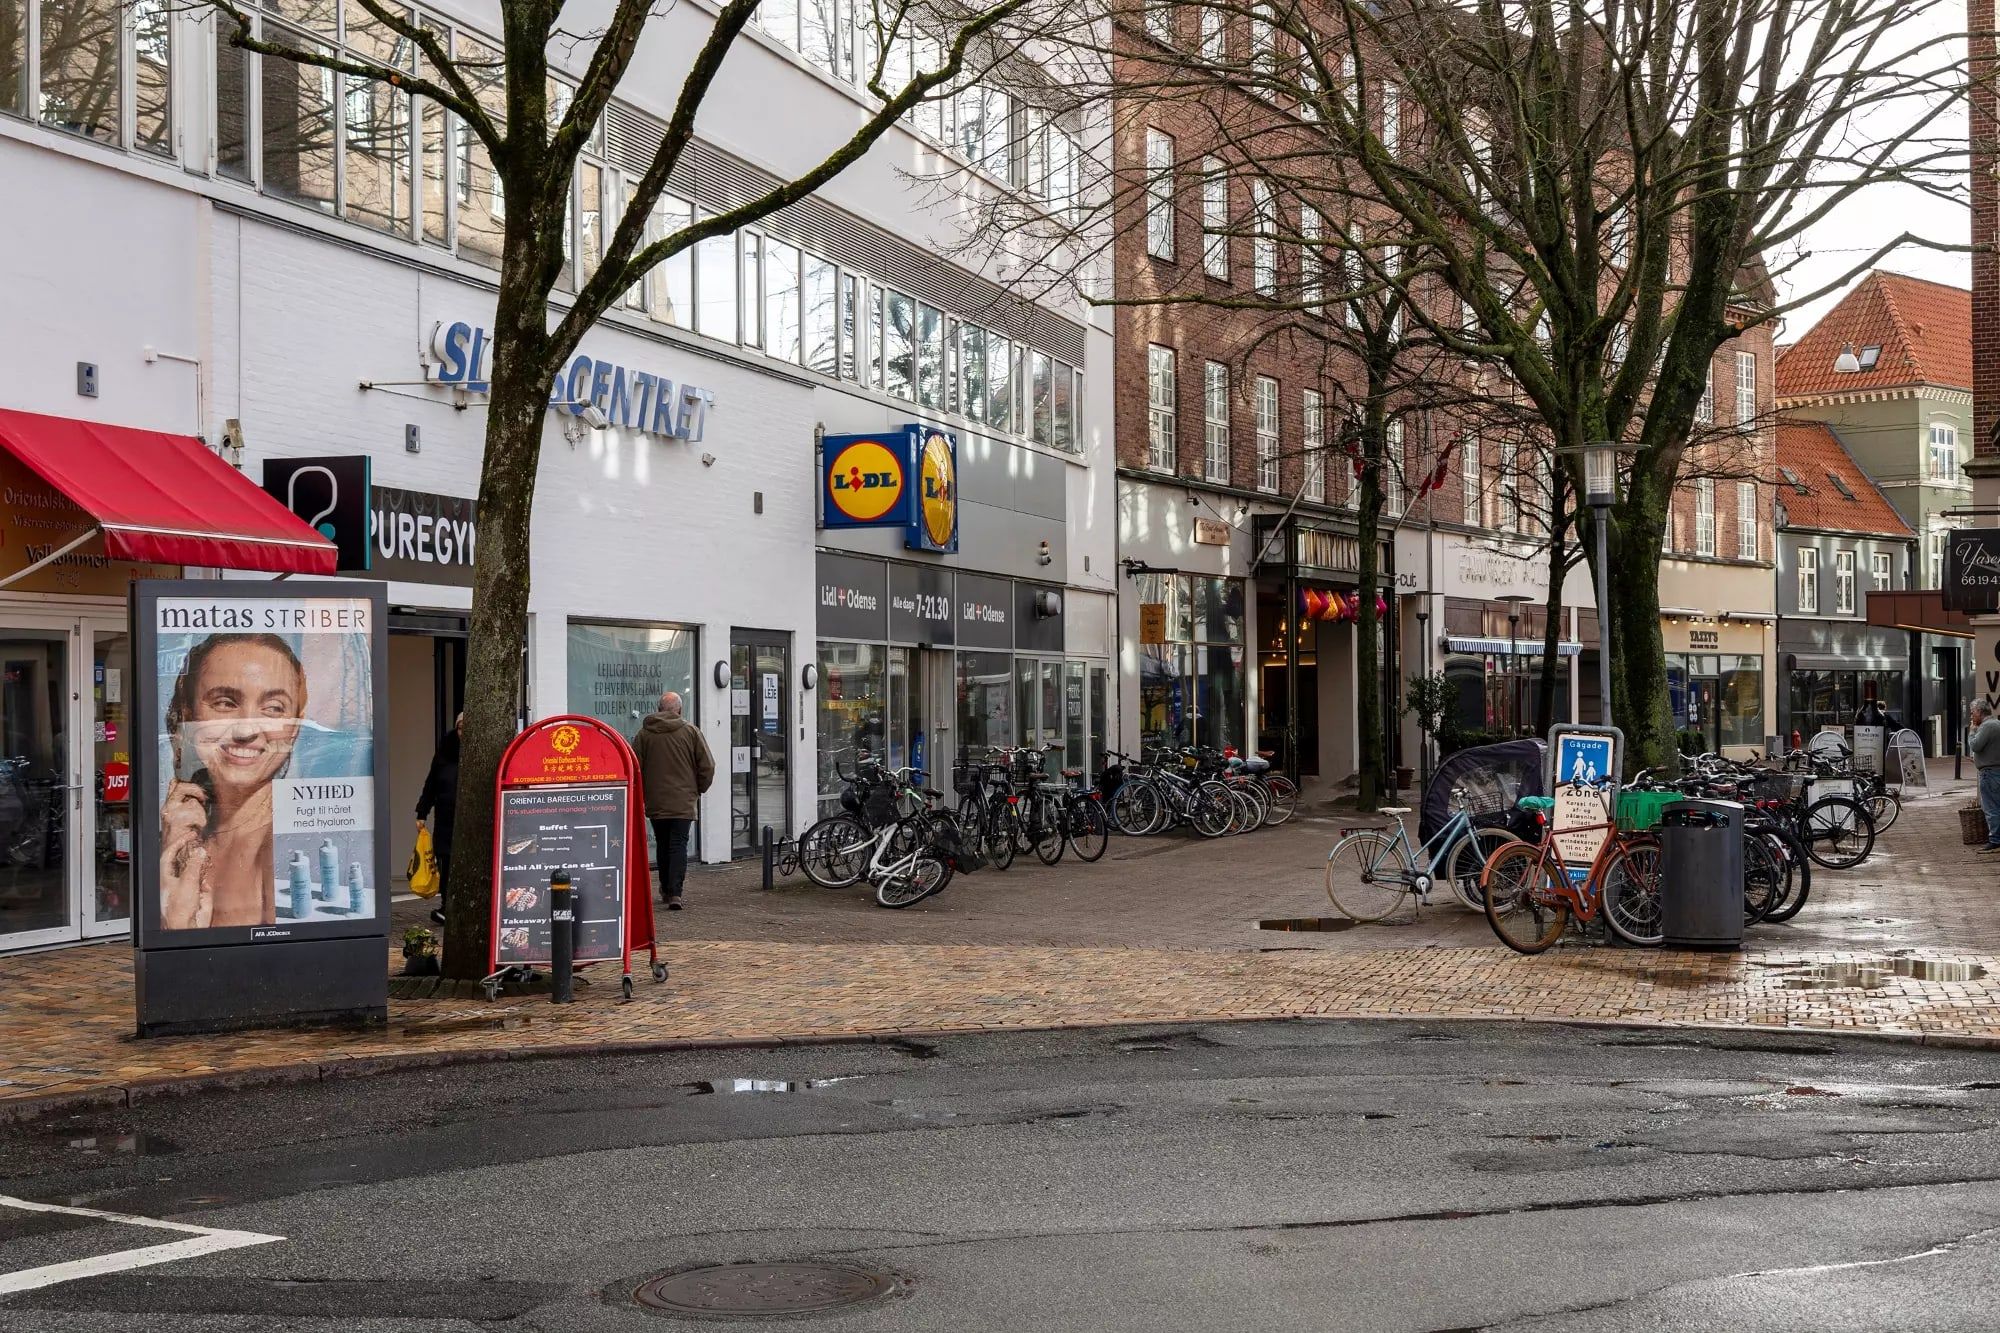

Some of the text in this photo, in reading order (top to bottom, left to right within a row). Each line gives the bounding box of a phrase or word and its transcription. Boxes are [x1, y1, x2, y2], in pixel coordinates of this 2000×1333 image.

[370, 508, 476, 567] UREGY
[1961, 575, 1976, 586] 66
[821, 584, 837, 607] Lidl
[847, 589, 877, 611] Odense
[892, 593, 949, 621] Alle dage 7-21.30
[963, 602, 975, 621] Lidl
[982, 605, 1005, 623] Odense
[161, 605, 365, 628] matas STRIBER
[597, 663, 662, 679] LEJLIGHEDER OG
[766, 677, 775, 688] TIL
[594, 700, 626, 717] UDLEJES
[1569, 740, 1602, 750] Gågade
[108, 775, 129, 790] JUST
[292, 784, 355, 800] NYHED
[509, 796, 546, 805] ORIENTAL
[587, 793, 614, 802] HOUSE
[1566, 786, 1600, 798] Zone
[296, 804, 352, 817] Fugt til håret
[293, 816, 355, 829] med hyaluron
[544, 863, 560, 872] you
[503, 918, 549, 926] Takeaway
